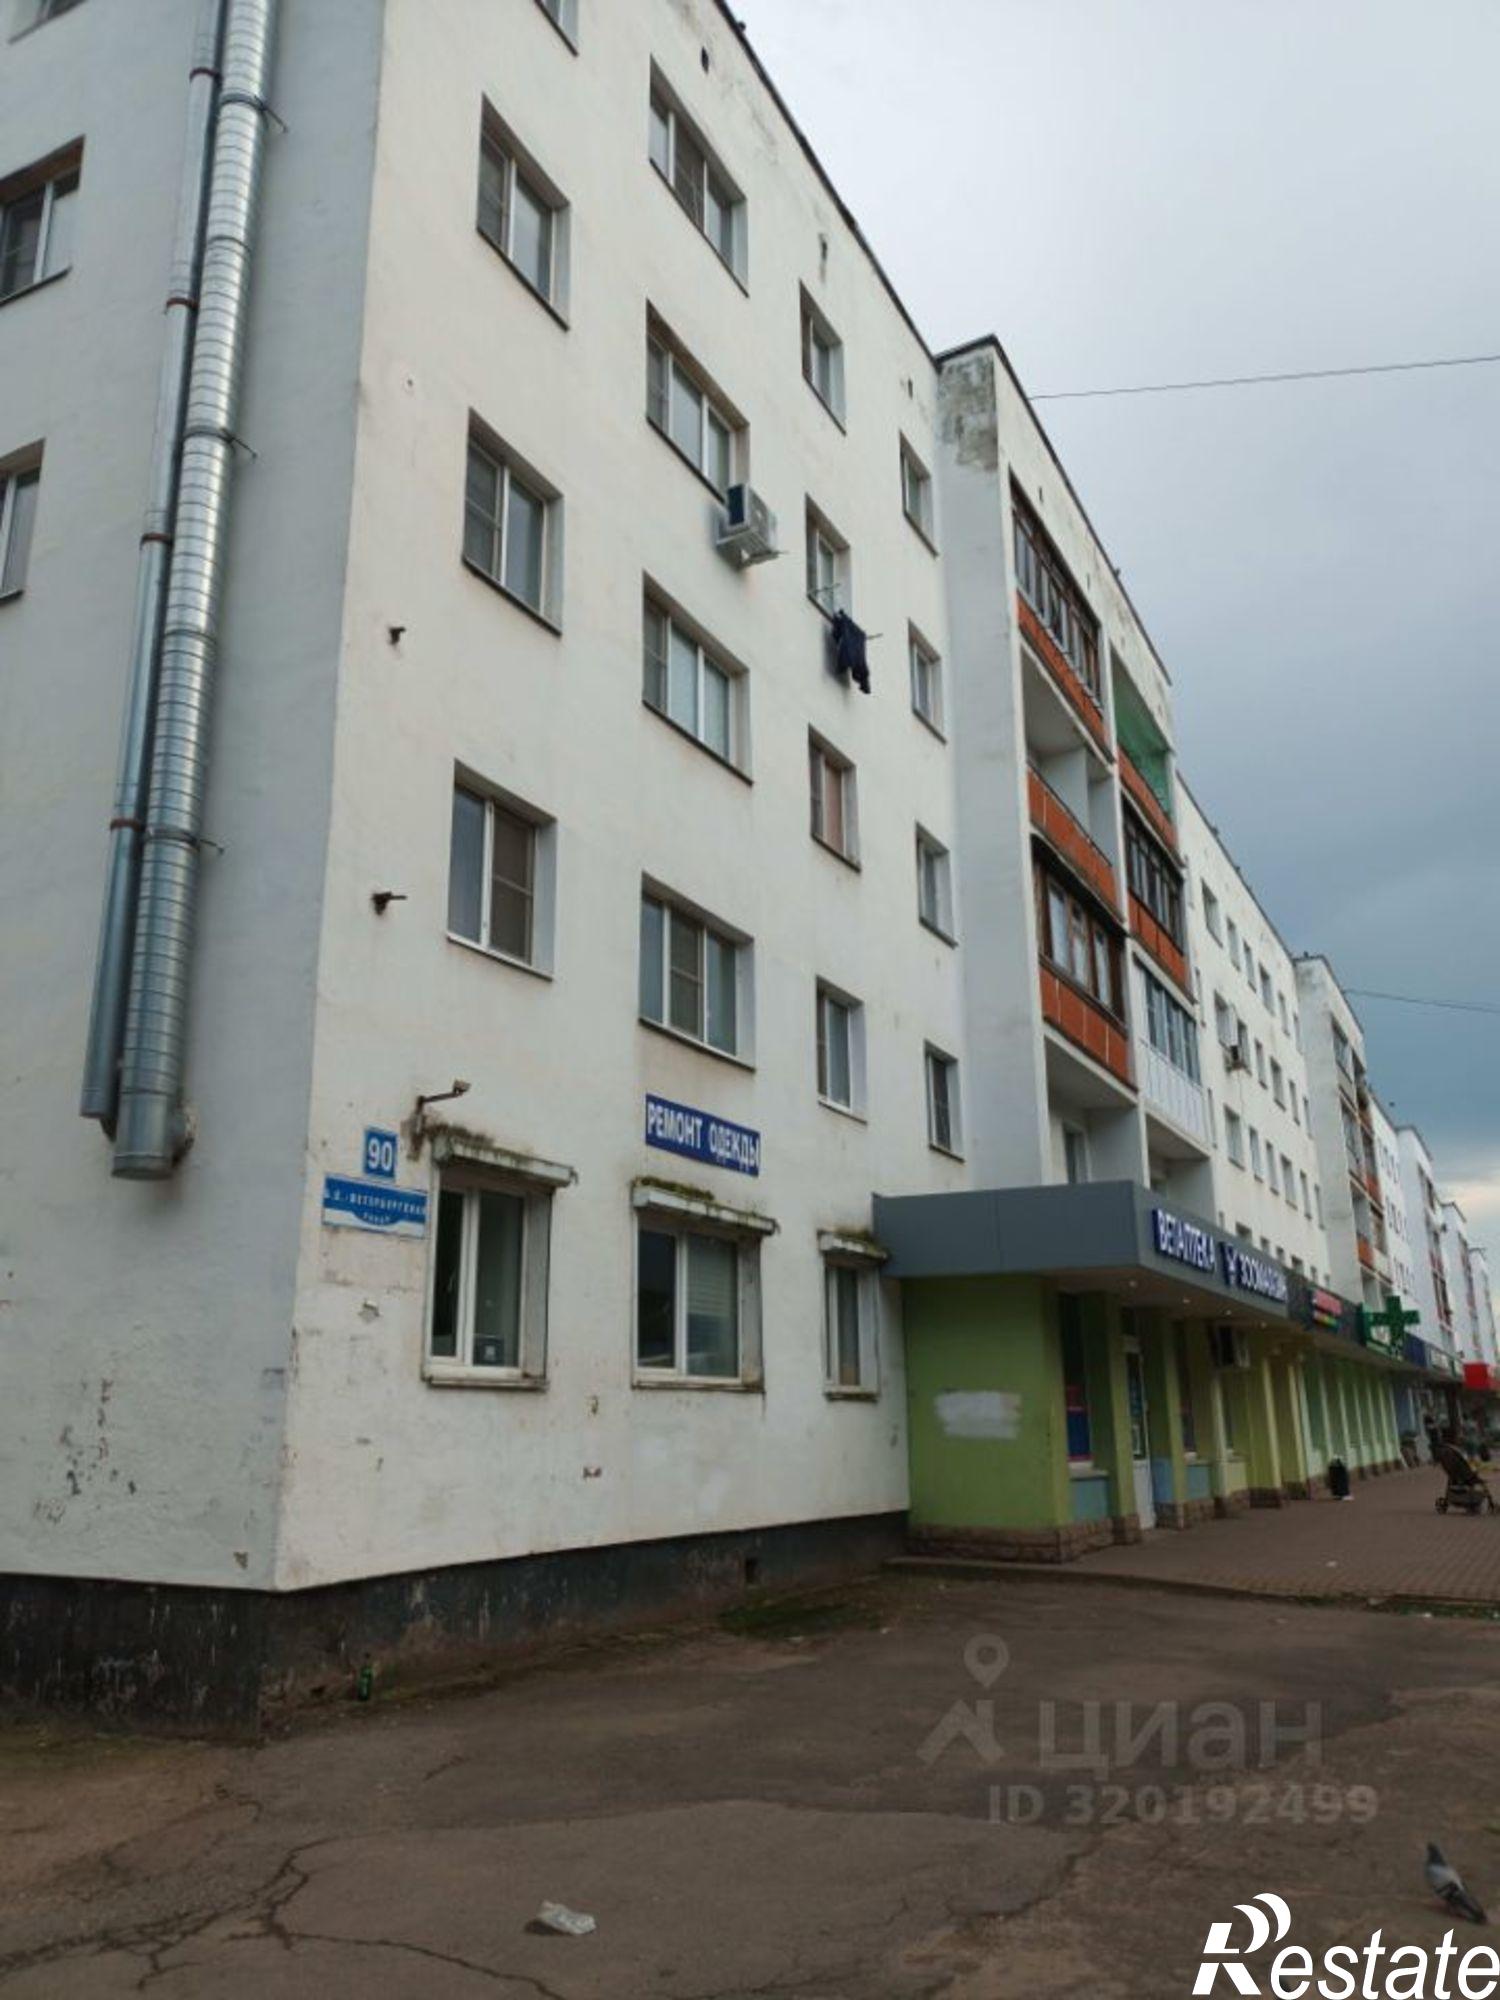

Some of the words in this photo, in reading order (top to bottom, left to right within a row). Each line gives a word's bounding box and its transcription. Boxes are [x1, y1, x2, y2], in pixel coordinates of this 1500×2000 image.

[367, 1137, 393, 1171] 90
[646, 1101, 703, 1150] РЕМОНТ
[708, 1121, 761, 1172] ОДЕЖДЫ
